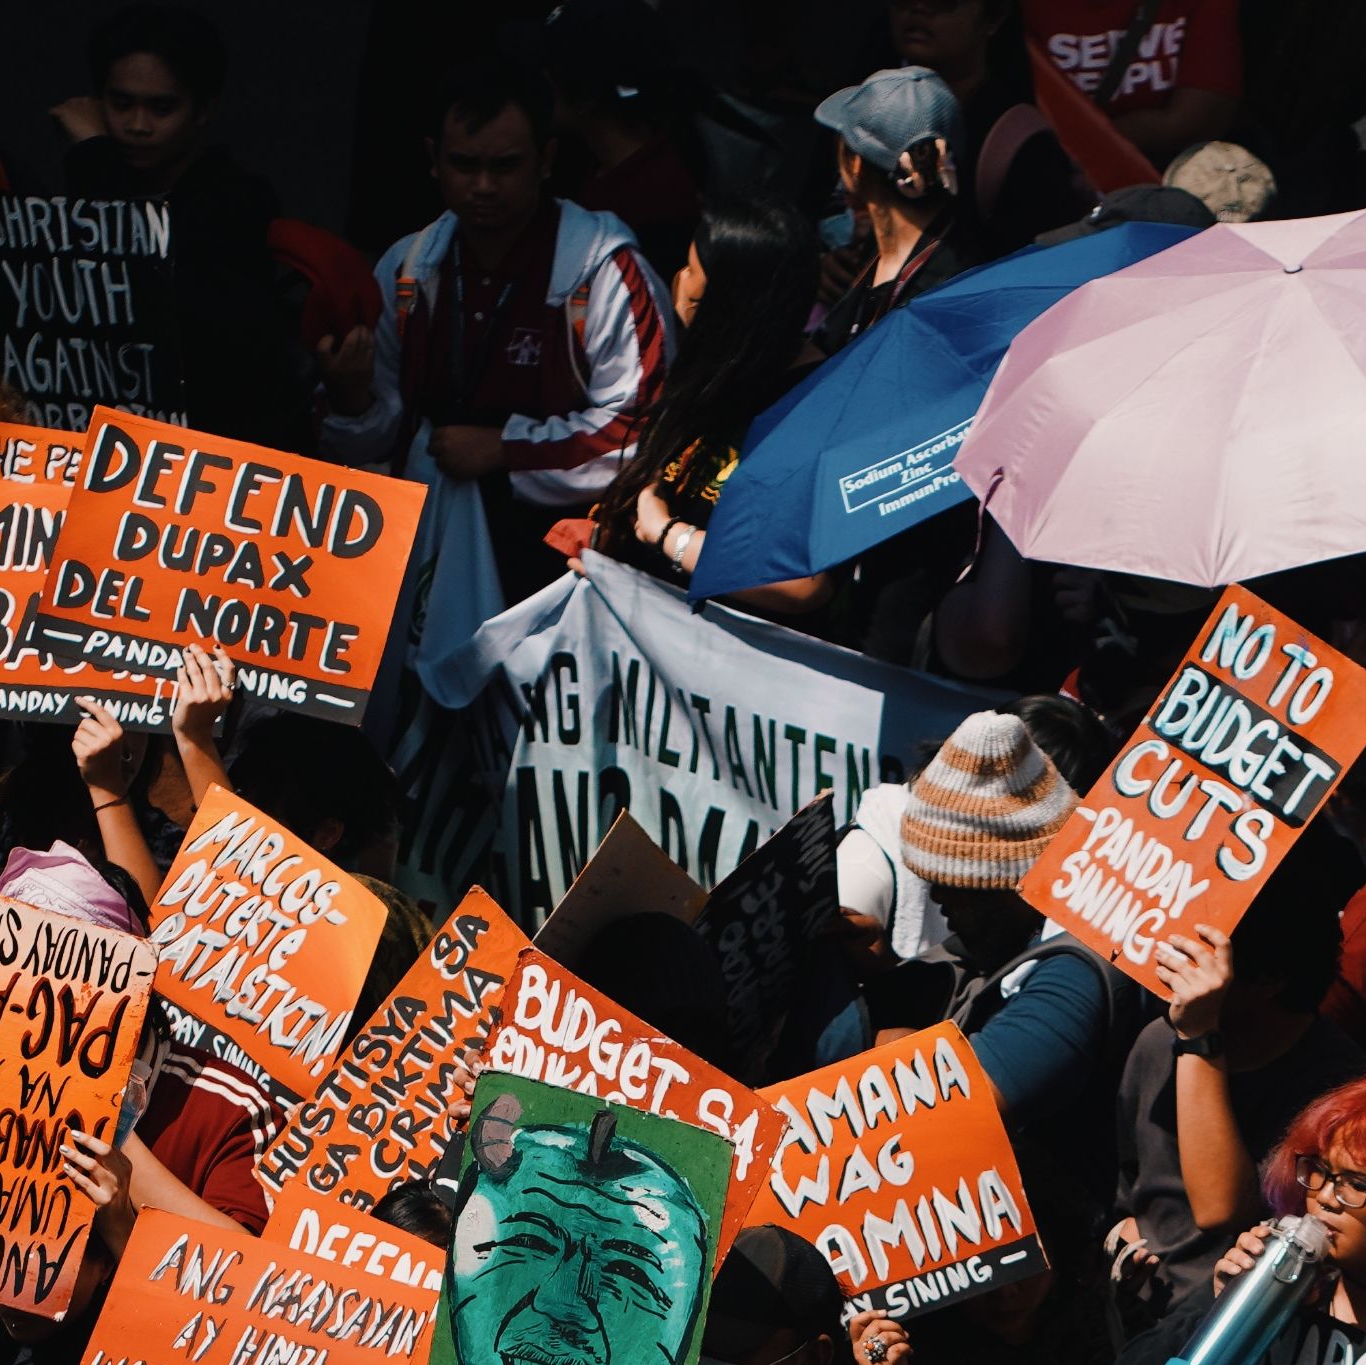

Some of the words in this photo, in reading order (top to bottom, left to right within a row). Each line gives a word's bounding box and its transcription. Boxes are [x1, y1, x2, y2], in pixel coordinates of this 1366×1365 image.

[1047, 16, 1188, 71] SEVE
[1, 256, 136, 330] YOUTH
[2, 332, 156, 404] AGAINST
[83, 422, 385, 560] DEFEND
[844, 461, 904, 494] Sodium
[900, 462, 934, 485] Zinc
[113, 510, 315, 600] DUPAX
[51, 559, 153, 623] DEL
[172, 586, 361, 676] NORTE
[82, 628, 186, 673] PANDA
[1199, 601, 1278, 681] NO
[1267, 643, 1335, 726] TO
[1154, 664, 1337, 816] BUDGET
[1113, 738, 1275, 882] CUTS
[1051, 850, 1167, 965] SINING
[20, 921, 135, 993] PANDAY
[259, 996, 429, 1193] HUSTISYA
[430, 913, 490, 981] SA
[347, 966, 506, 1141] BIKTIMA
[20, 1064, 67, 1117] NA
[148, 1232, 244, 1304] ANG
[886, 1254, 995, 1323] SINING
[172, 1311, 228, 1363] AY
